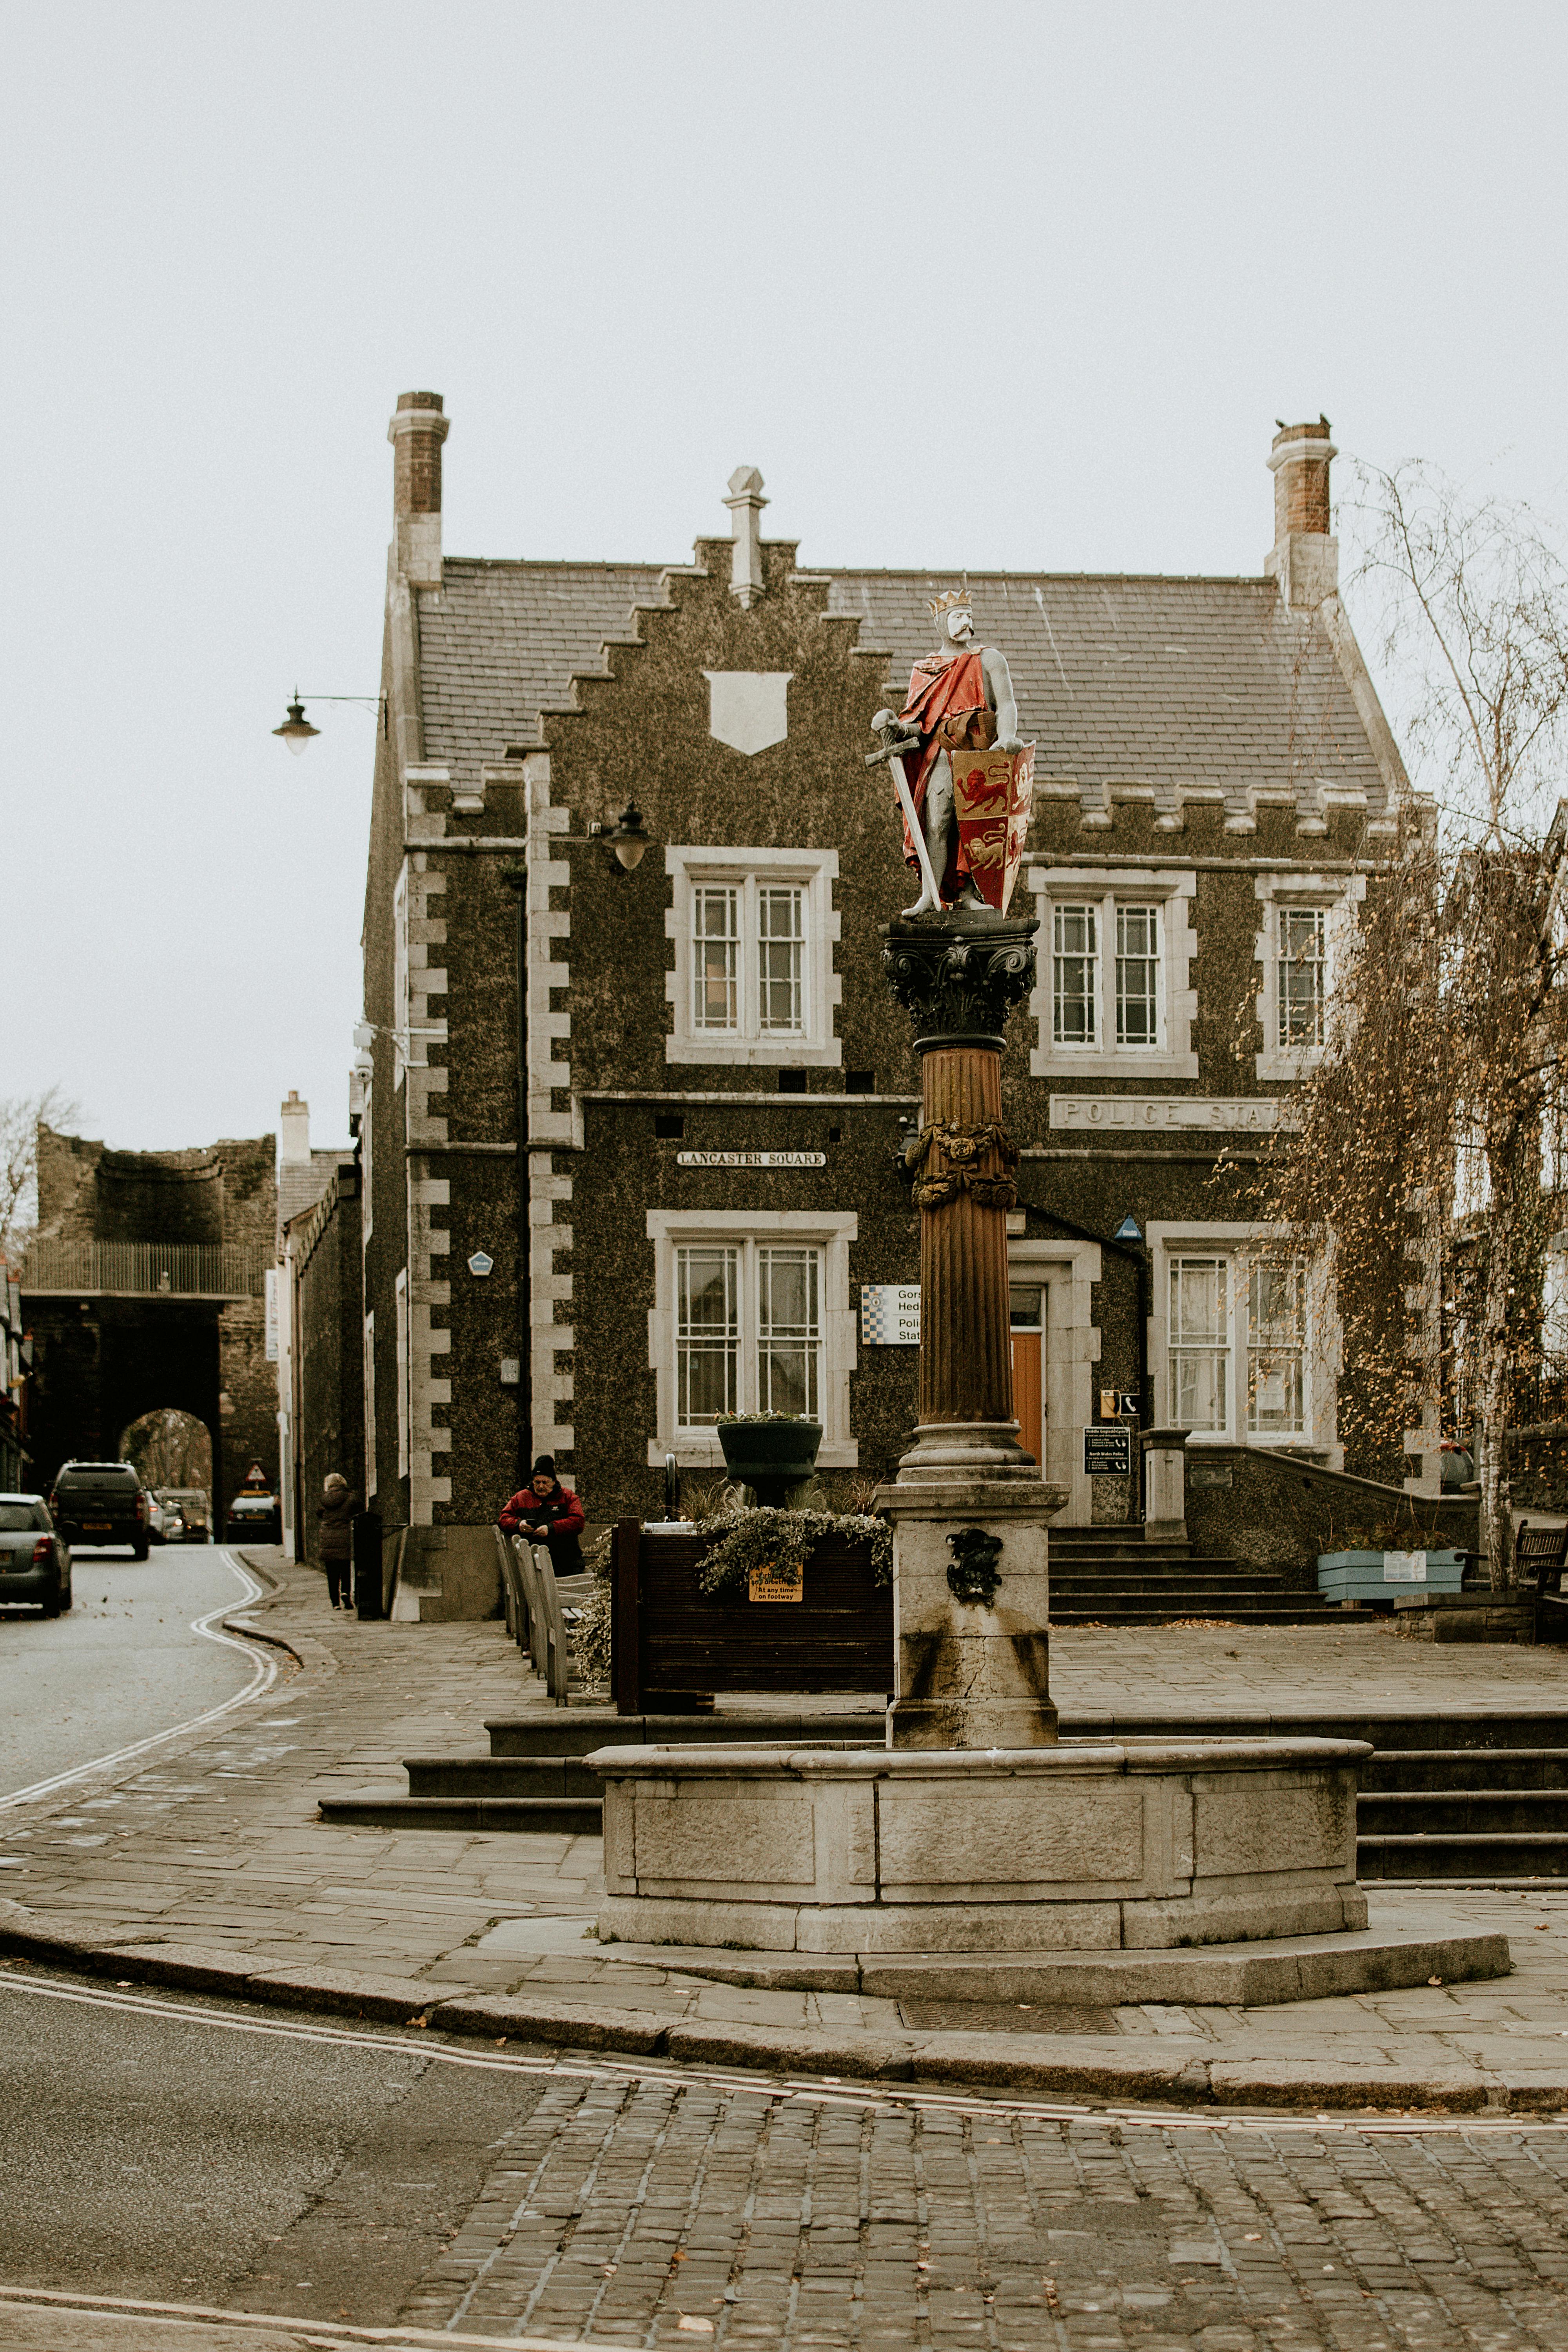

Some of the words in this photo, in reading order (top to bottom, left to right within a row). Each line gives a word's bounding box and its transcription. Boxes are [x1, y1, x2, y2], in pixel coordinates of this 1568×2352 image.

[1063, 1103, 1180, 1124] POLICE
[681, 1153, 762, 1164] LANCASTER
[769, 1154, 822, 1164] SQUARE
[899, 1319, 921, 1327] Poli
